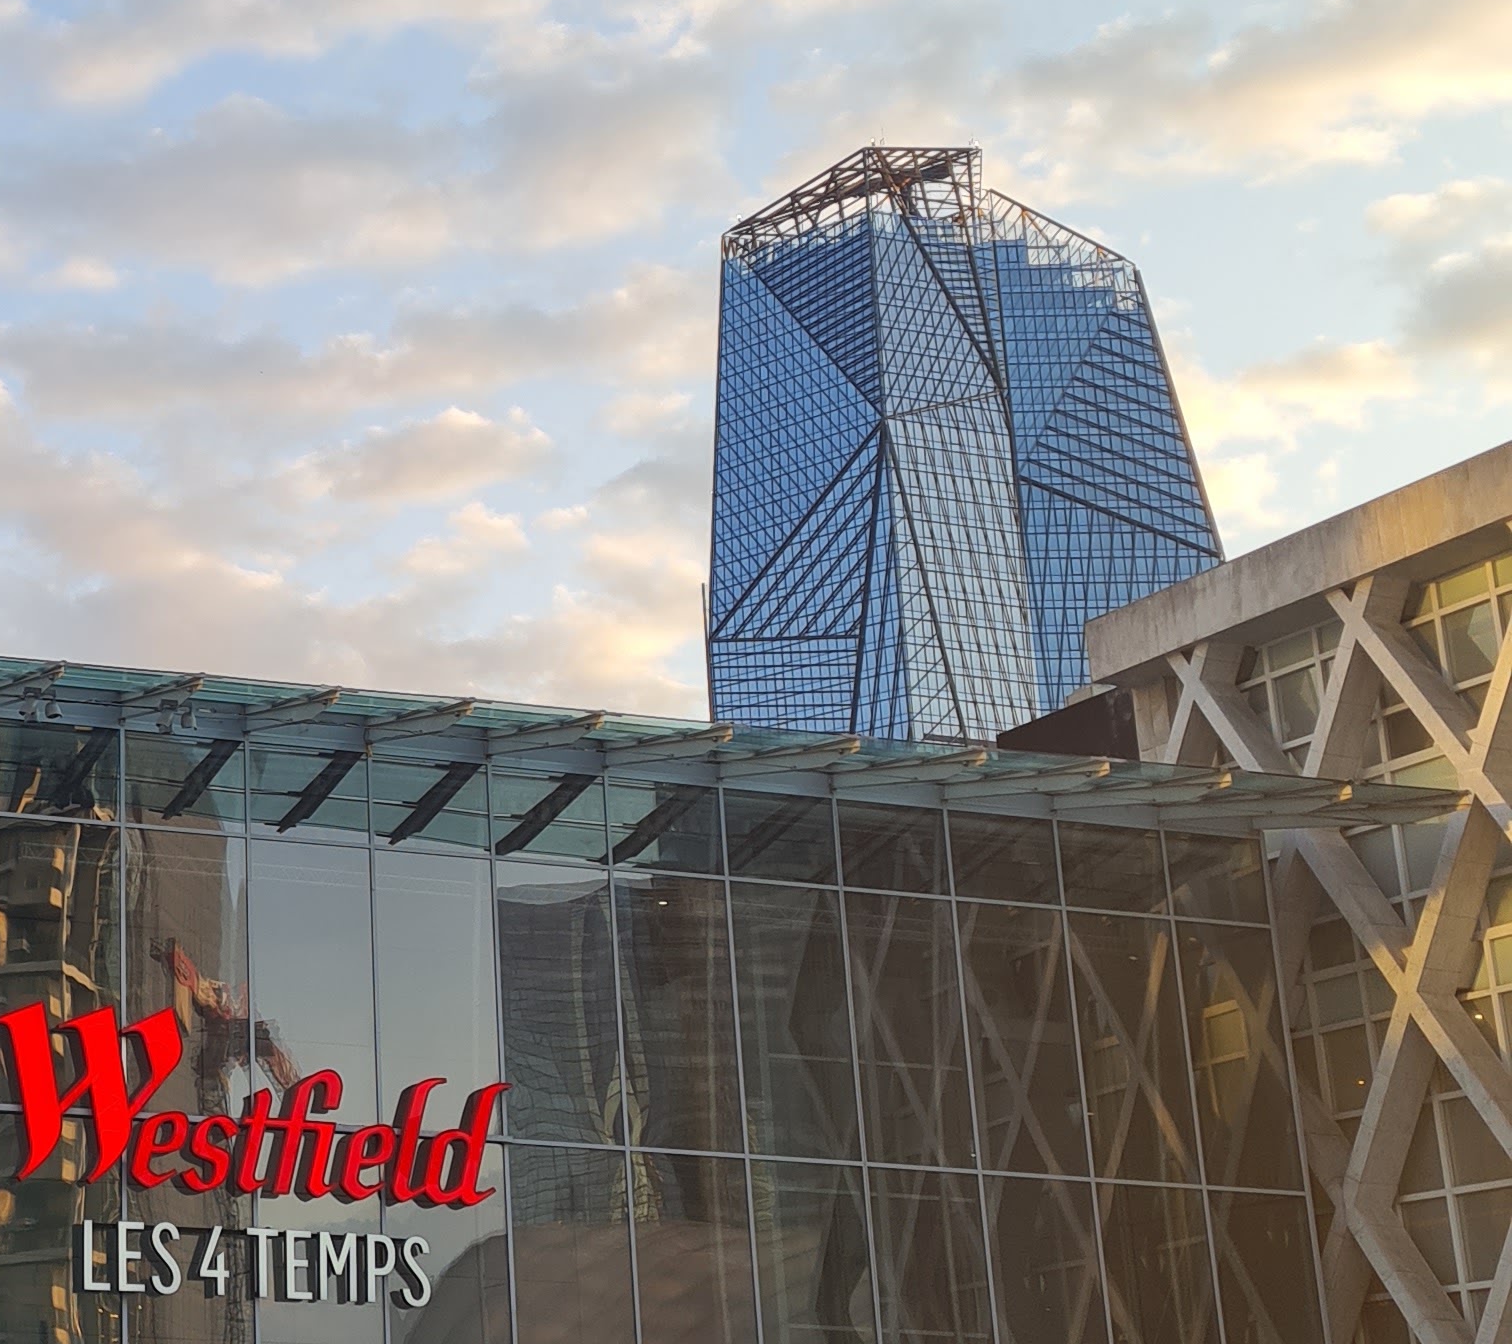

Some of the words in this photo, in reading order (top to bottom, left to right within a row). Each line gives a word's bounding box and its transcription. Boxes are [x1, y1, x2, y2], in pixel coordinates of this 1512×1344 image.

[83, 1219, 183, 1295] LES
[199, 1225, 230, 1297] 4
[246, 1227, 432, 1309] TEMPS
